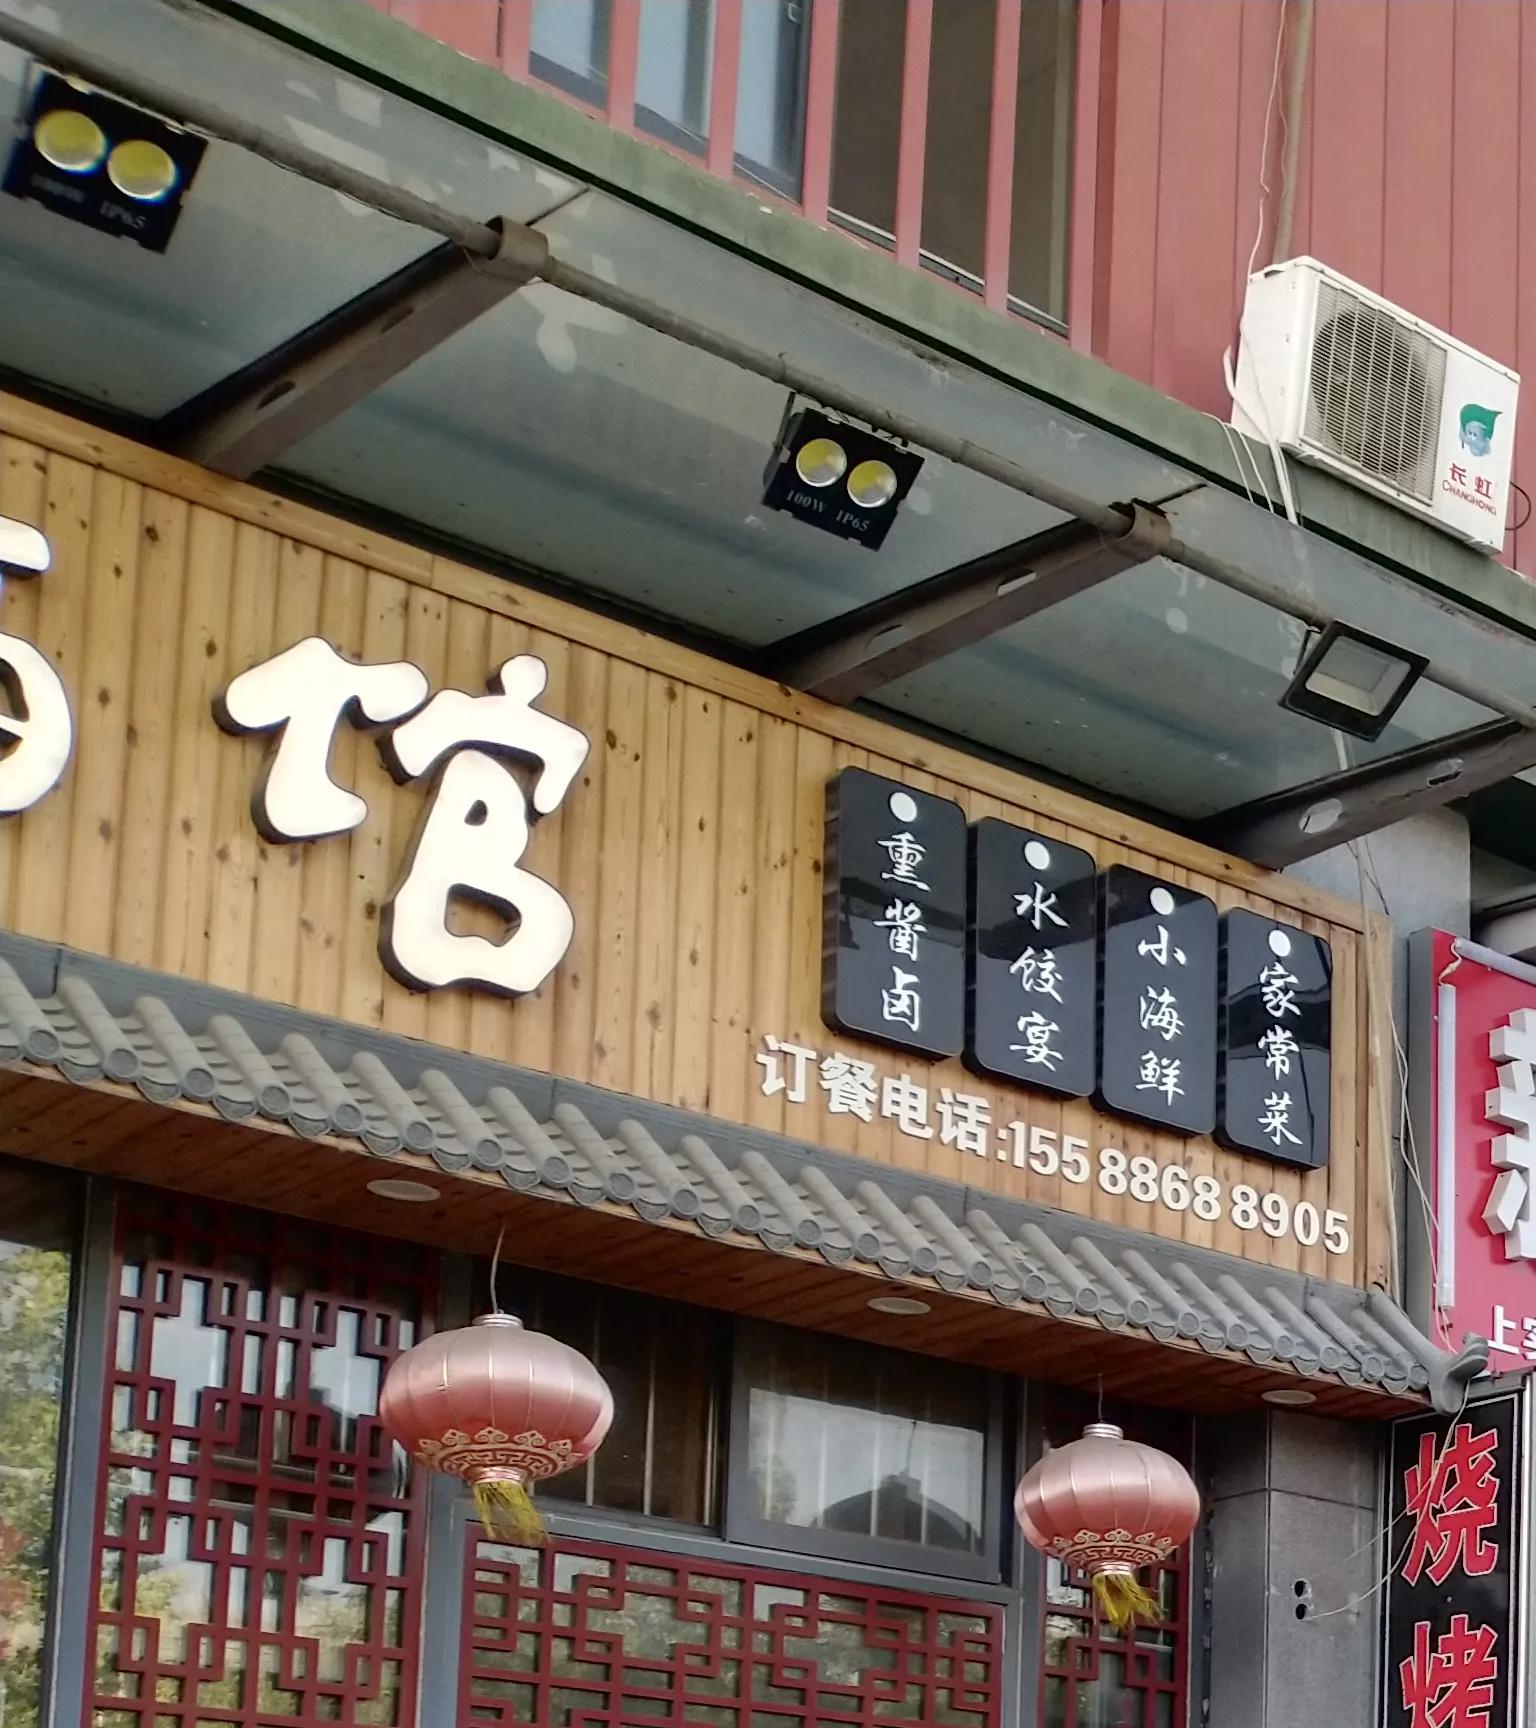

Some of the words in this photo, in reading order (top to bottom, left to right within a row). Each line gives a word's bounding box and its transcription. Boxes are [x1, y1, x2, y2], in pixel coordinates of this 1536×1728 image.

[786, 490, 828, 514] 100W
[836, 510, 873, 532] IP65
[1442, 479, 1497, 516] CHANGHONG
[1449, 463, 1493, 500] 长虹
[1009, 882, 1070, 1073] 水饺宴
[1136, 925, 1189, 1107] 小海鲜
[1257, 962, 1304, 1148] 家常菜
